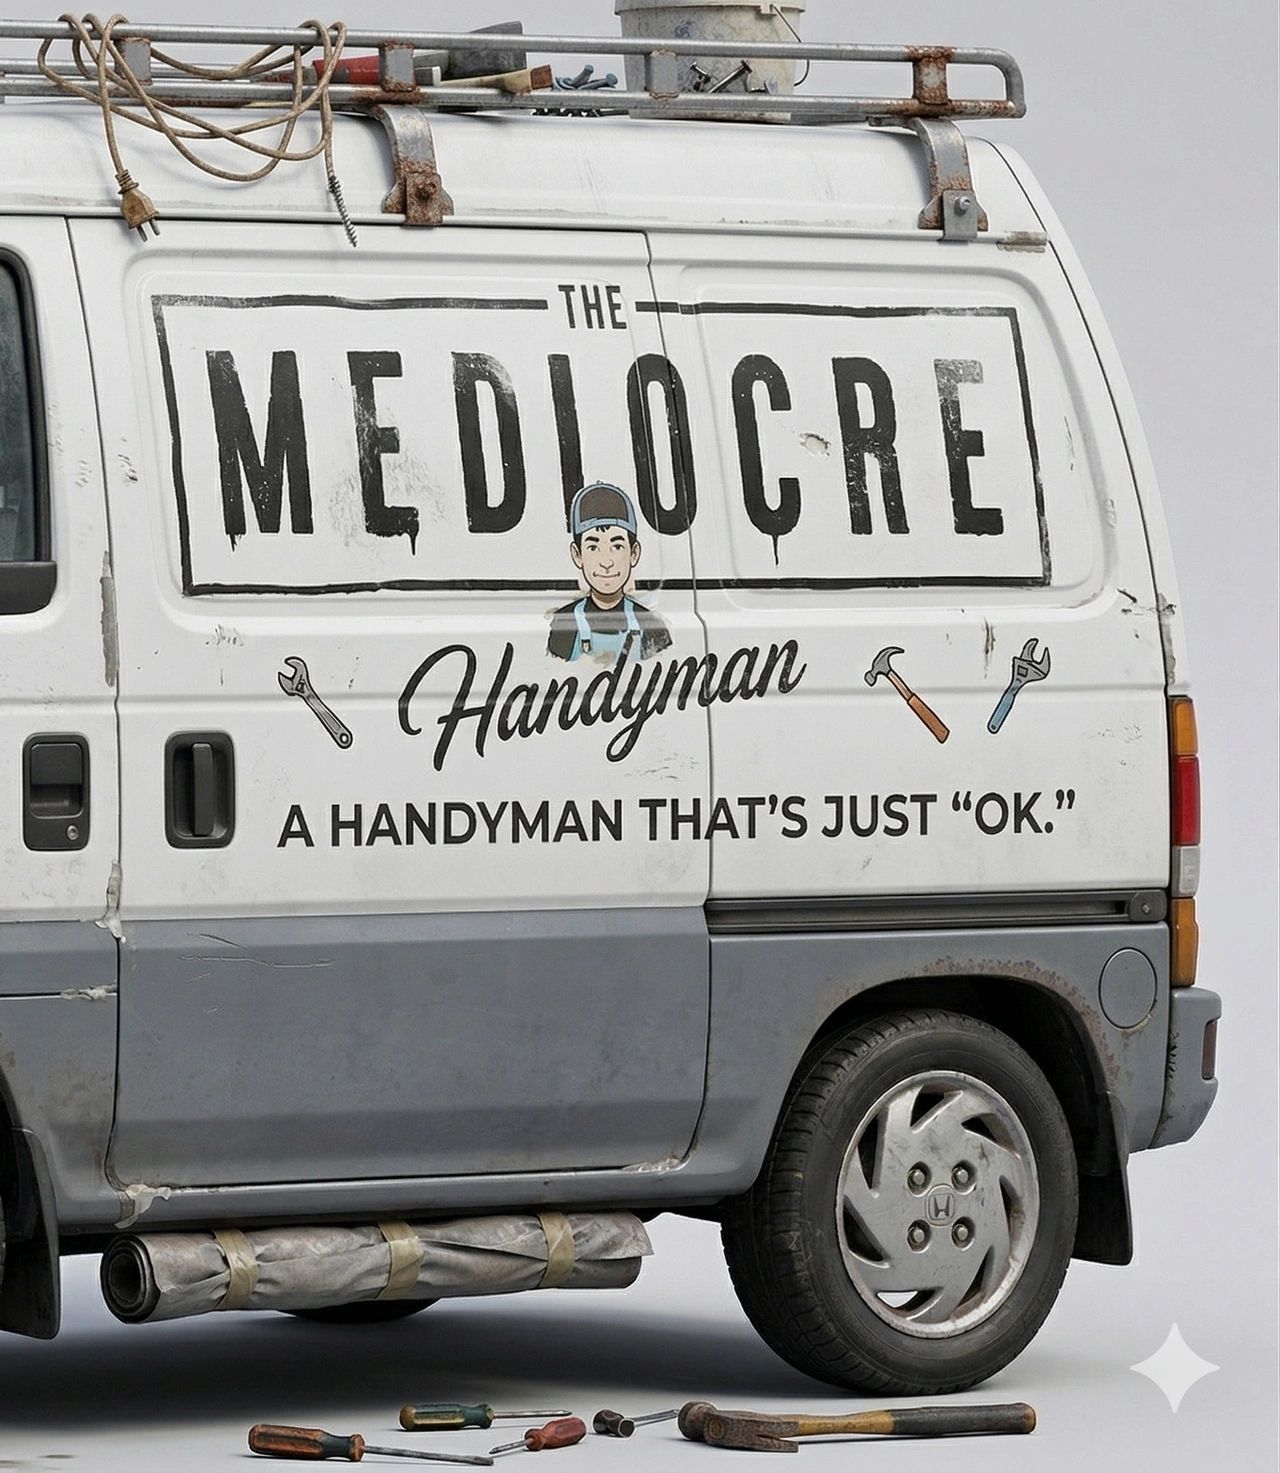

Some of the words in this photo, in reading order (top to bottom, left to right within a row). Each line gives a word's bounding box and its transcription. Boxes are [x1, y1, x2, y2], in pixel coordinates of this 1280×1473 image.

[558, 284, 627, 331] THE
[205, 350, 1004, 565] MEDIOCRE
[397, 639, 807, 772] Handyman
[276, 804, 315, 848] A
[331, 799, 623, 848] HANDYMAN
[638, 795, 808, 843] THAT’S
[821, 793, 938, 839] JUST
